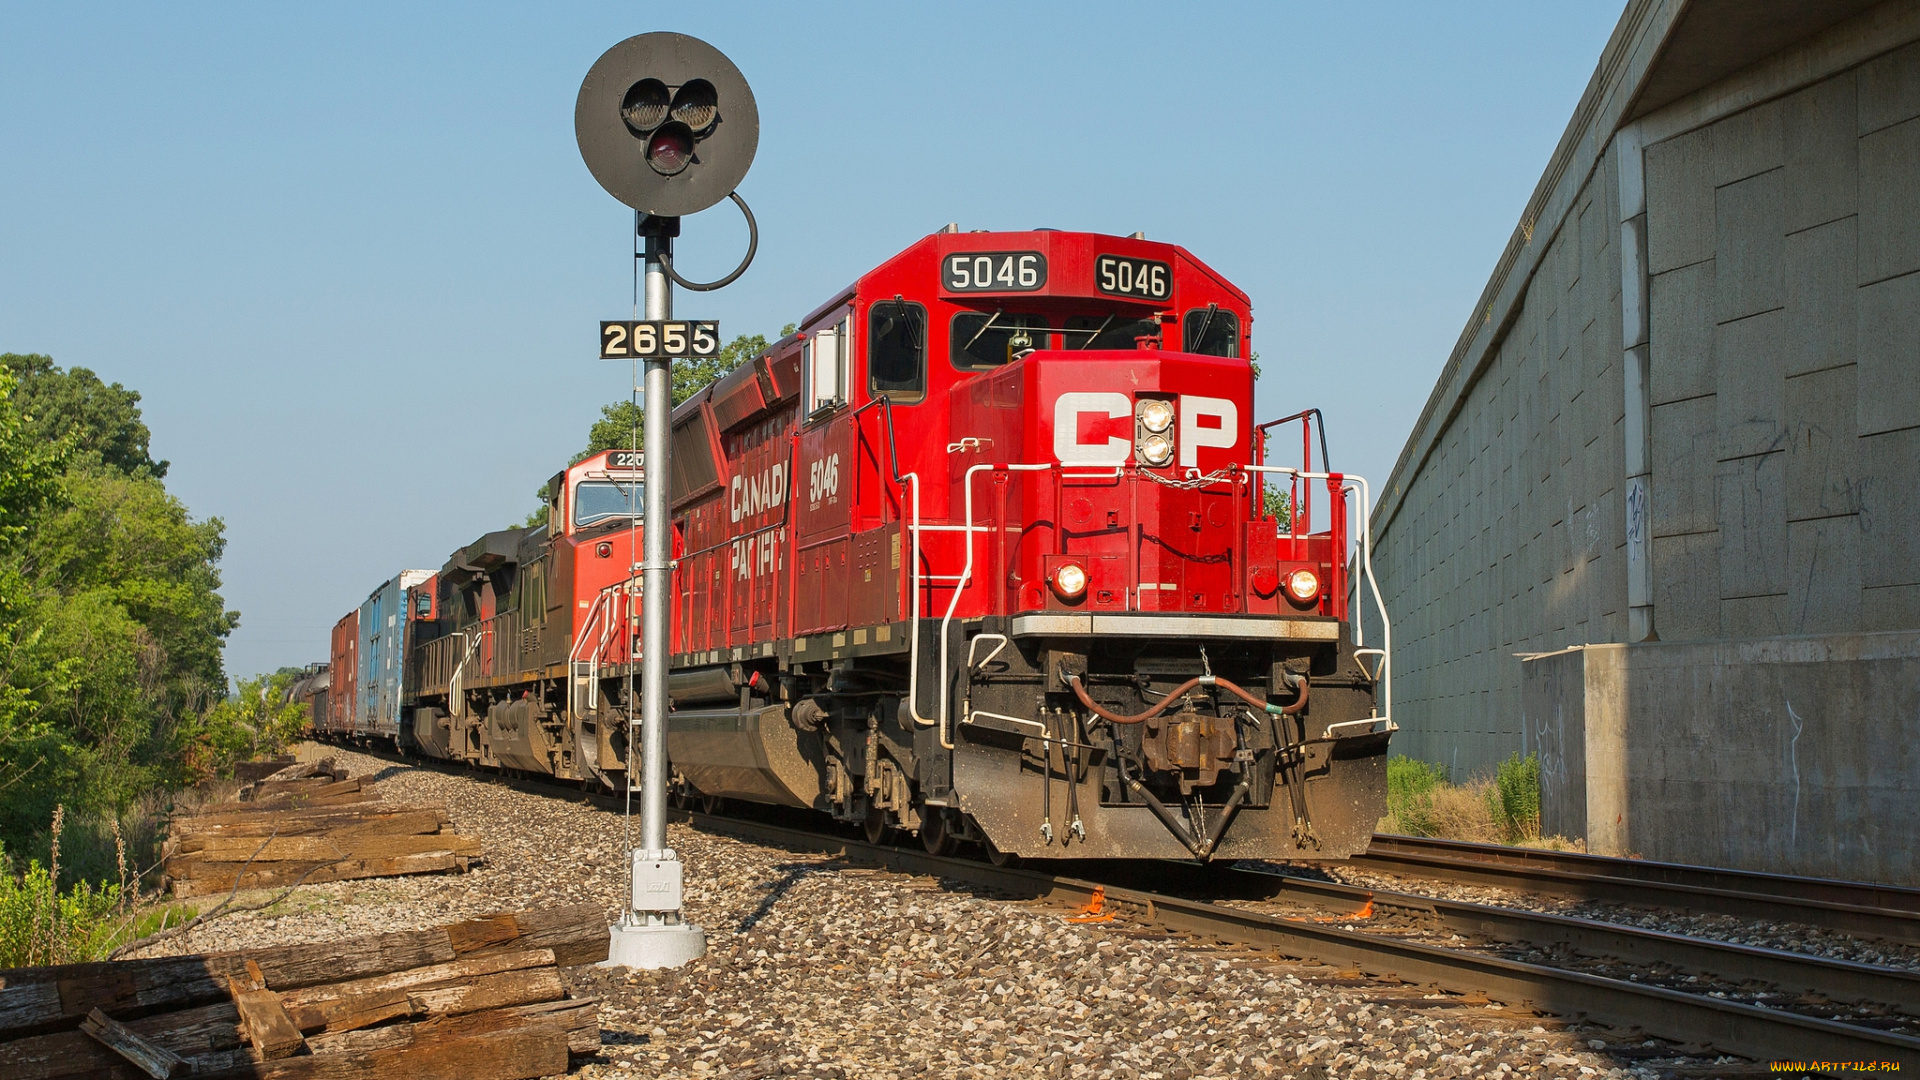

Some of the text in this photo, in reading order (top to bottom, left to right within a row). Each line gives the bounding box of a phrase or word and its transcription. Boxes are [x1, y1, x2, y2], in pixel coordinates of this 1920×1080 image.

[951, 255, 1038, 289] 5046
[1101, 258, 1166, 297] 5046
[603, 323, 716, 355] 2655
[1053, 391, 1239, 468] CP
[616, 453, 645, 467] 220
[810, 452, 839, 503] 5046
